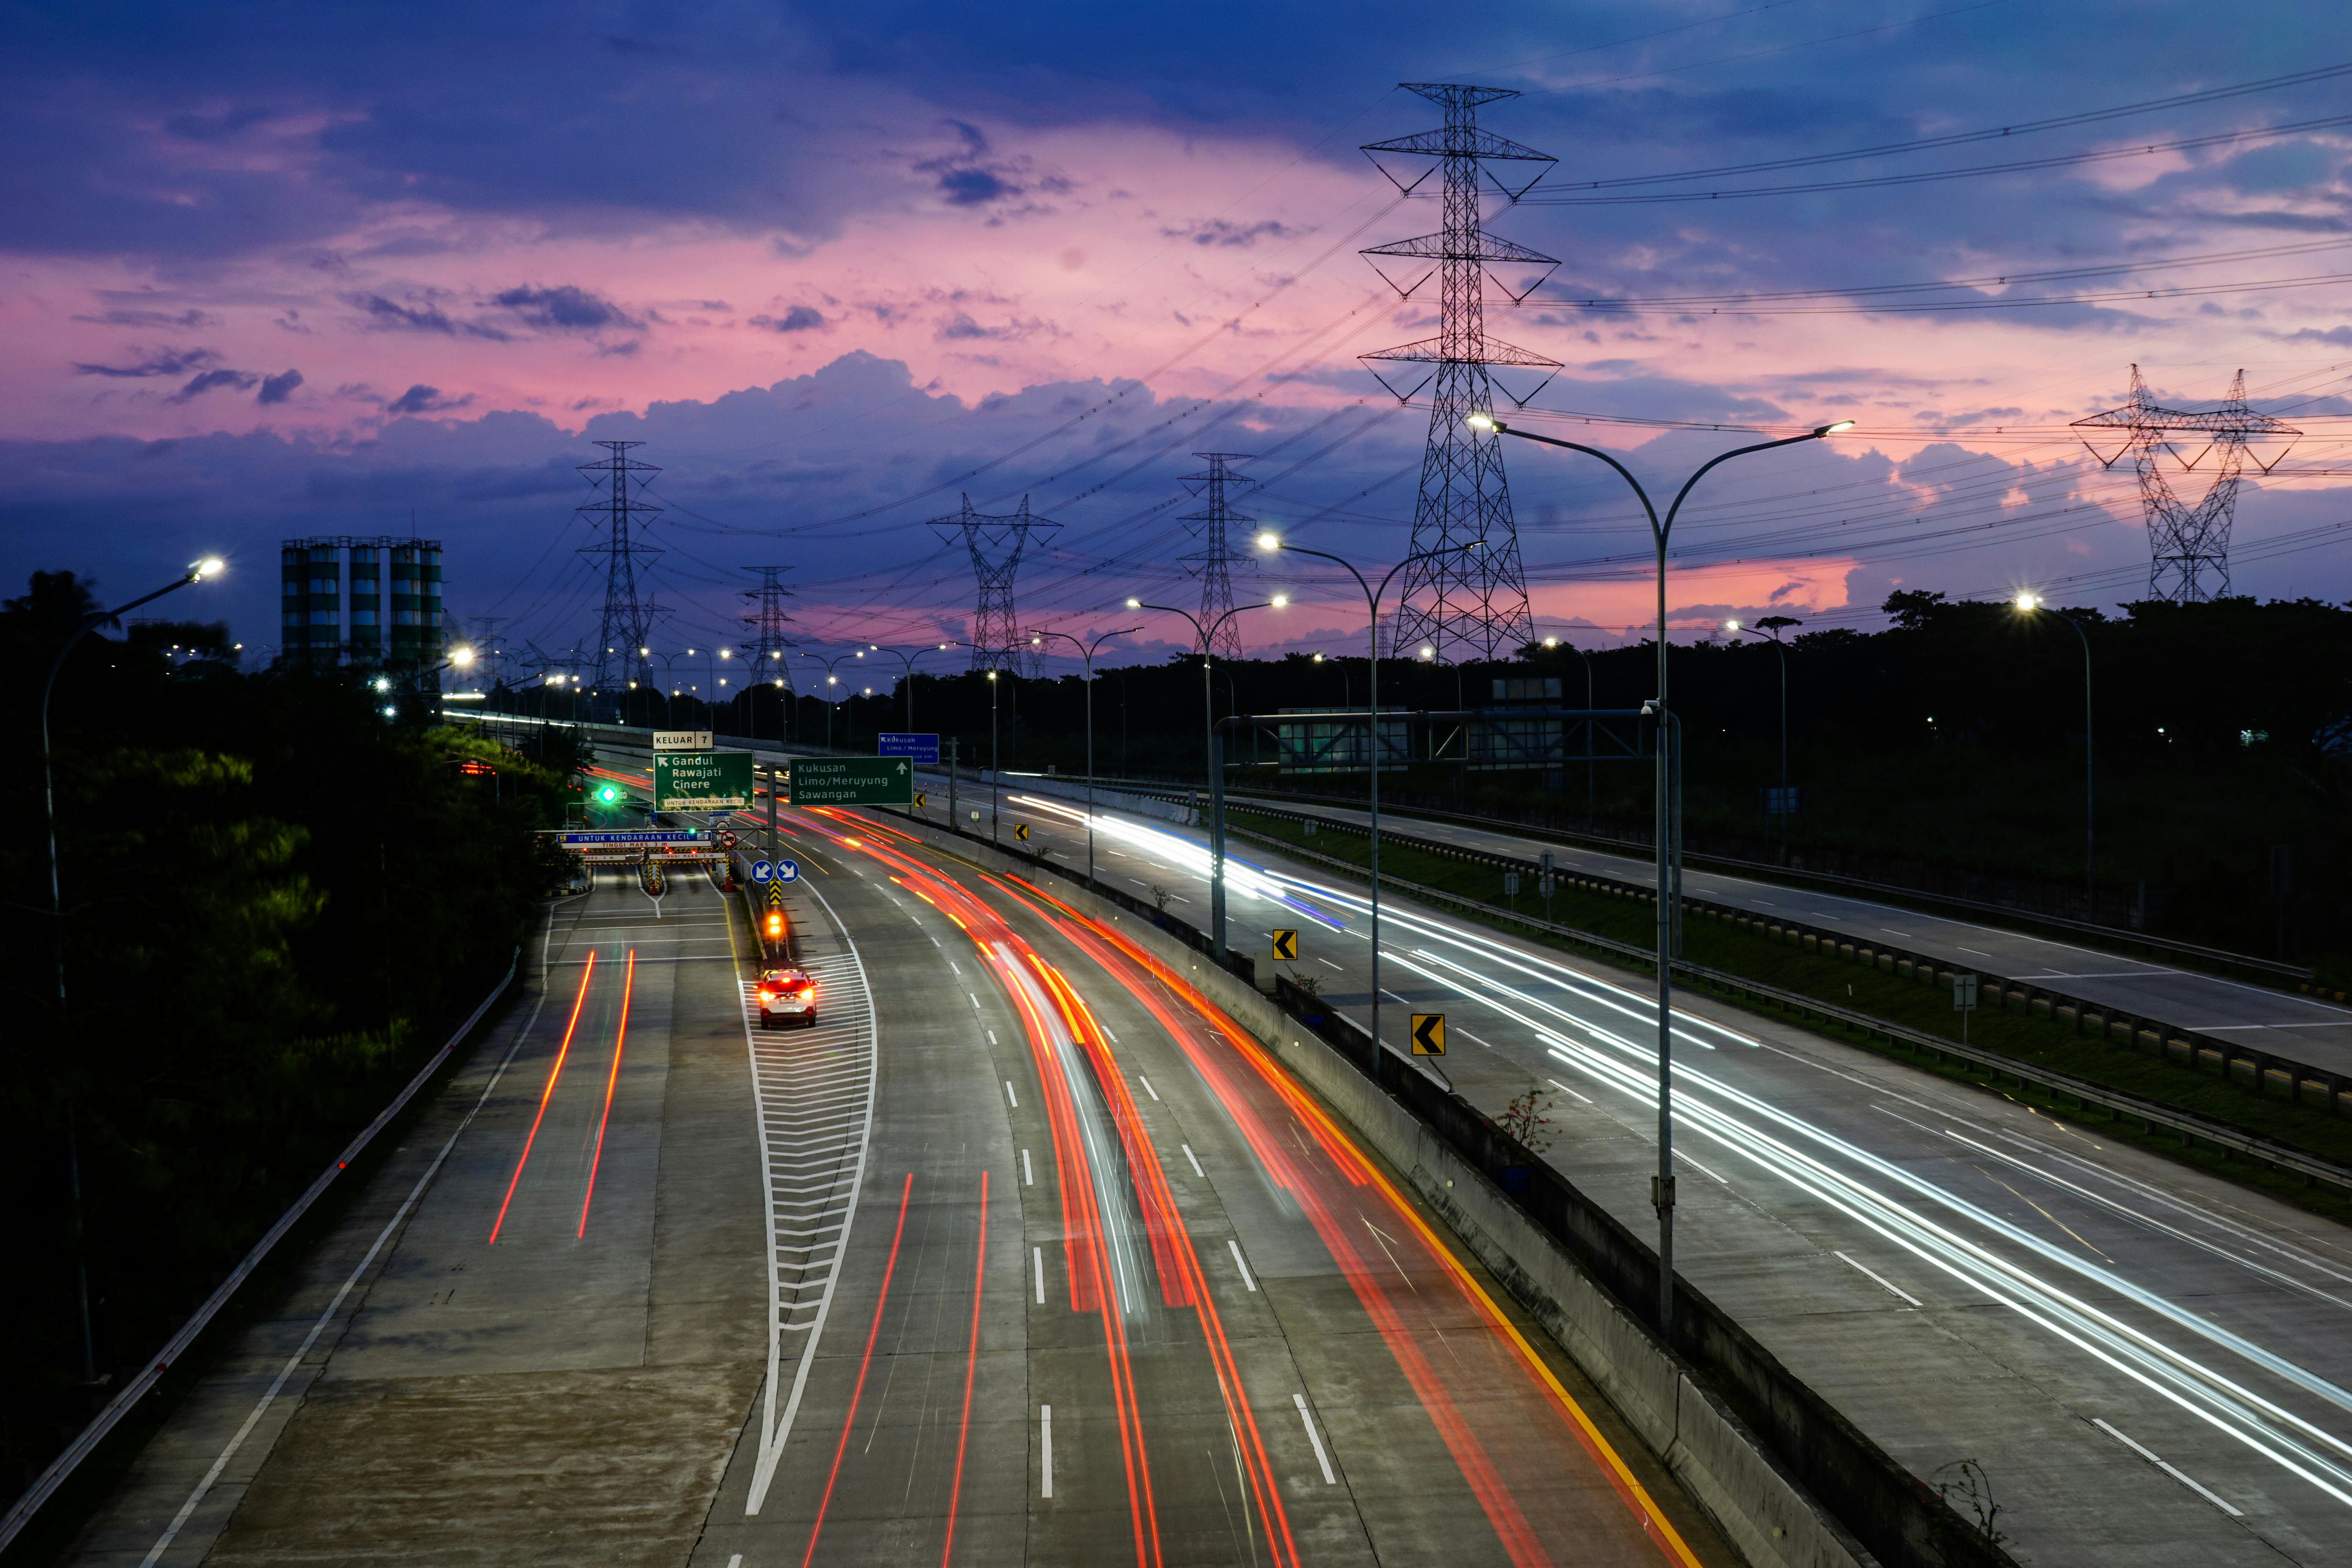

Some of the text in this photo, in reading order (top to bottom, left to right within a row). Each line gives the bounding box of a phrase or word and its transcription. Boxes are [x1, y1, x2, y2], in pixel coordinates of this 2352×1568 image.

[672, 756, 713, 765] Gandul
[799, 764, 846, 773] Kukusan
[672, 768, 721, 779] Rawajati
[673, 780, 710, 789] Cinere
[799, 777, 888, 787] Limo/Meruyung
[799, 791, 856, 800] Sawangan
